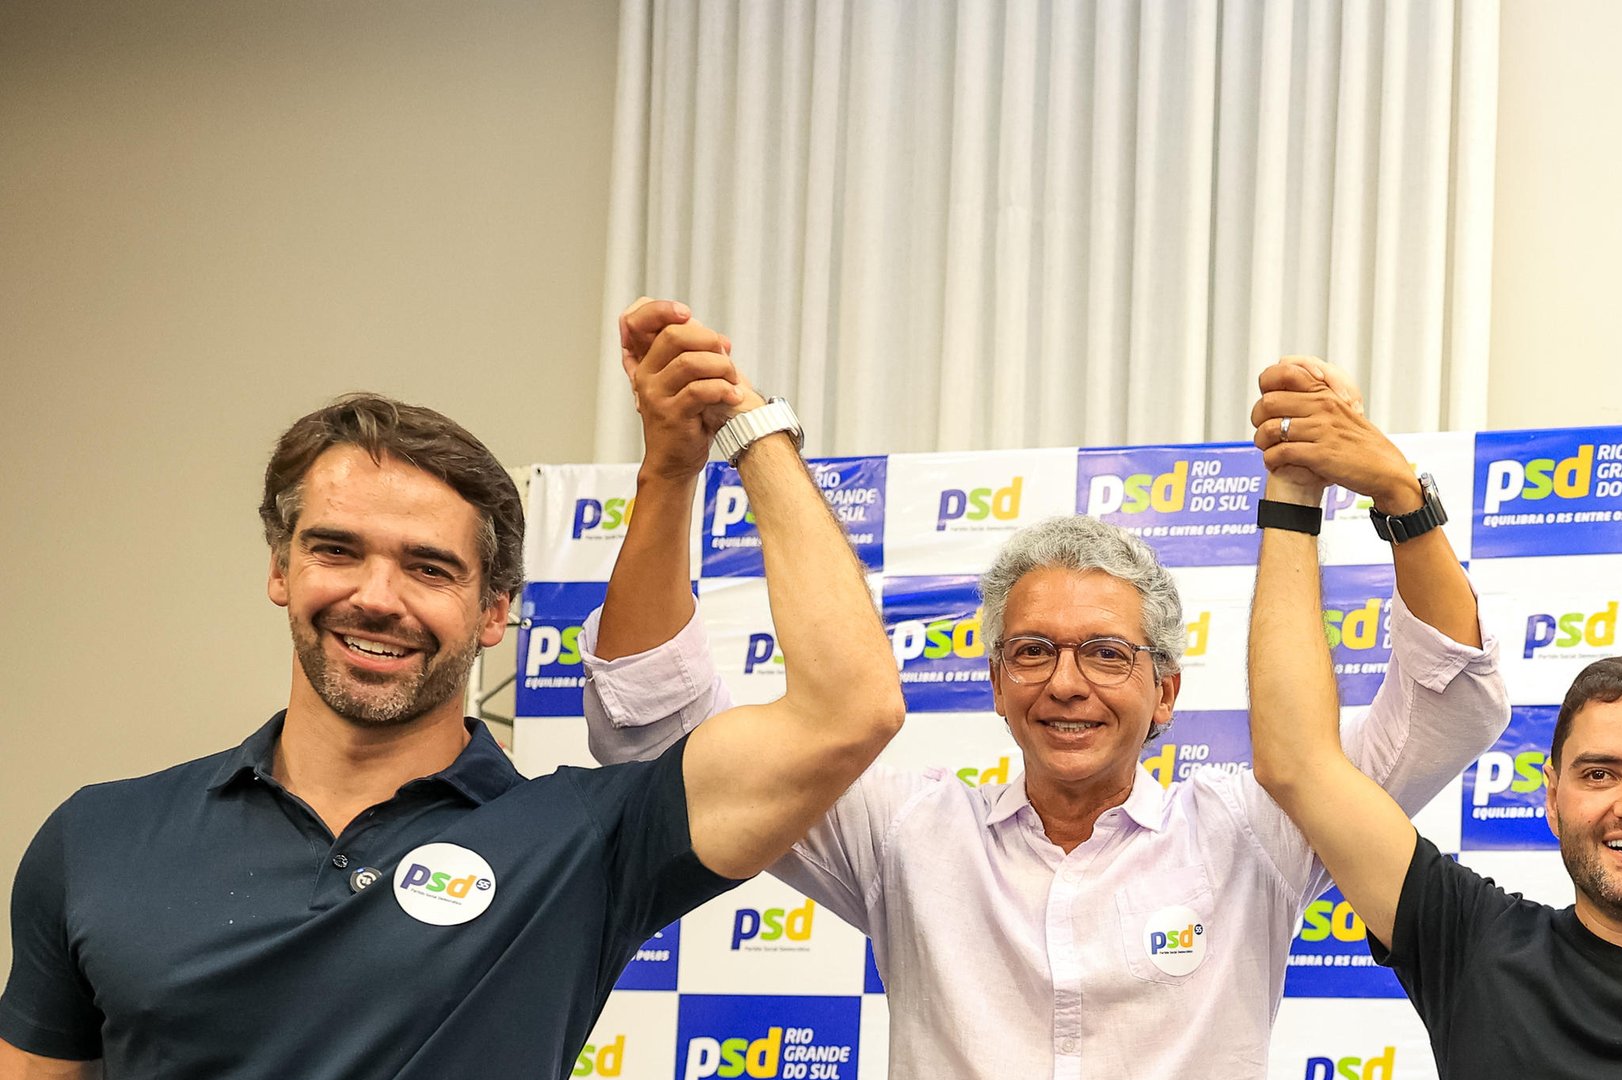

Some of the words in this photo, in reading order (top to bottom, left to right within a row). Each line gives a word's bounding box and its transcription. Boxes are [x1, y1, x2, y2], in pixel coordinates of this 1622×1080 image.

[1191, 461, 1221, 477] RIO
[1483, 445, 1593, 513] psd
[1191, 475, 1261, 496] GRANDE
[1596, 481, 1622, 497] DO
[936, 476, 1023, 531] psd
[1190, 496, 1215, 511] DO
[1218, 495, 1249, 511] SUL
[1484, 512, 1544, 527] EQUILIBRA
[1546, 514, 1555, 523] O
[1556, 513, 1573, 523] RS
[1574, 511, 1611, 522] ENTRE
[1523, 602, 1618, 659] psd
[1473, 752, 1550, 805] ps
[400, 863, 476, 898] psd
[730, 899, 815, 951] psd
[1151, 924, 1193, 954] psd
[785, 1028, 813, 1044] RIO
[784, 1046, 850, 1064] GRANDE
[783, 1063, 806, 1079] DO
[810, 1064, 839, 1079] SUL
